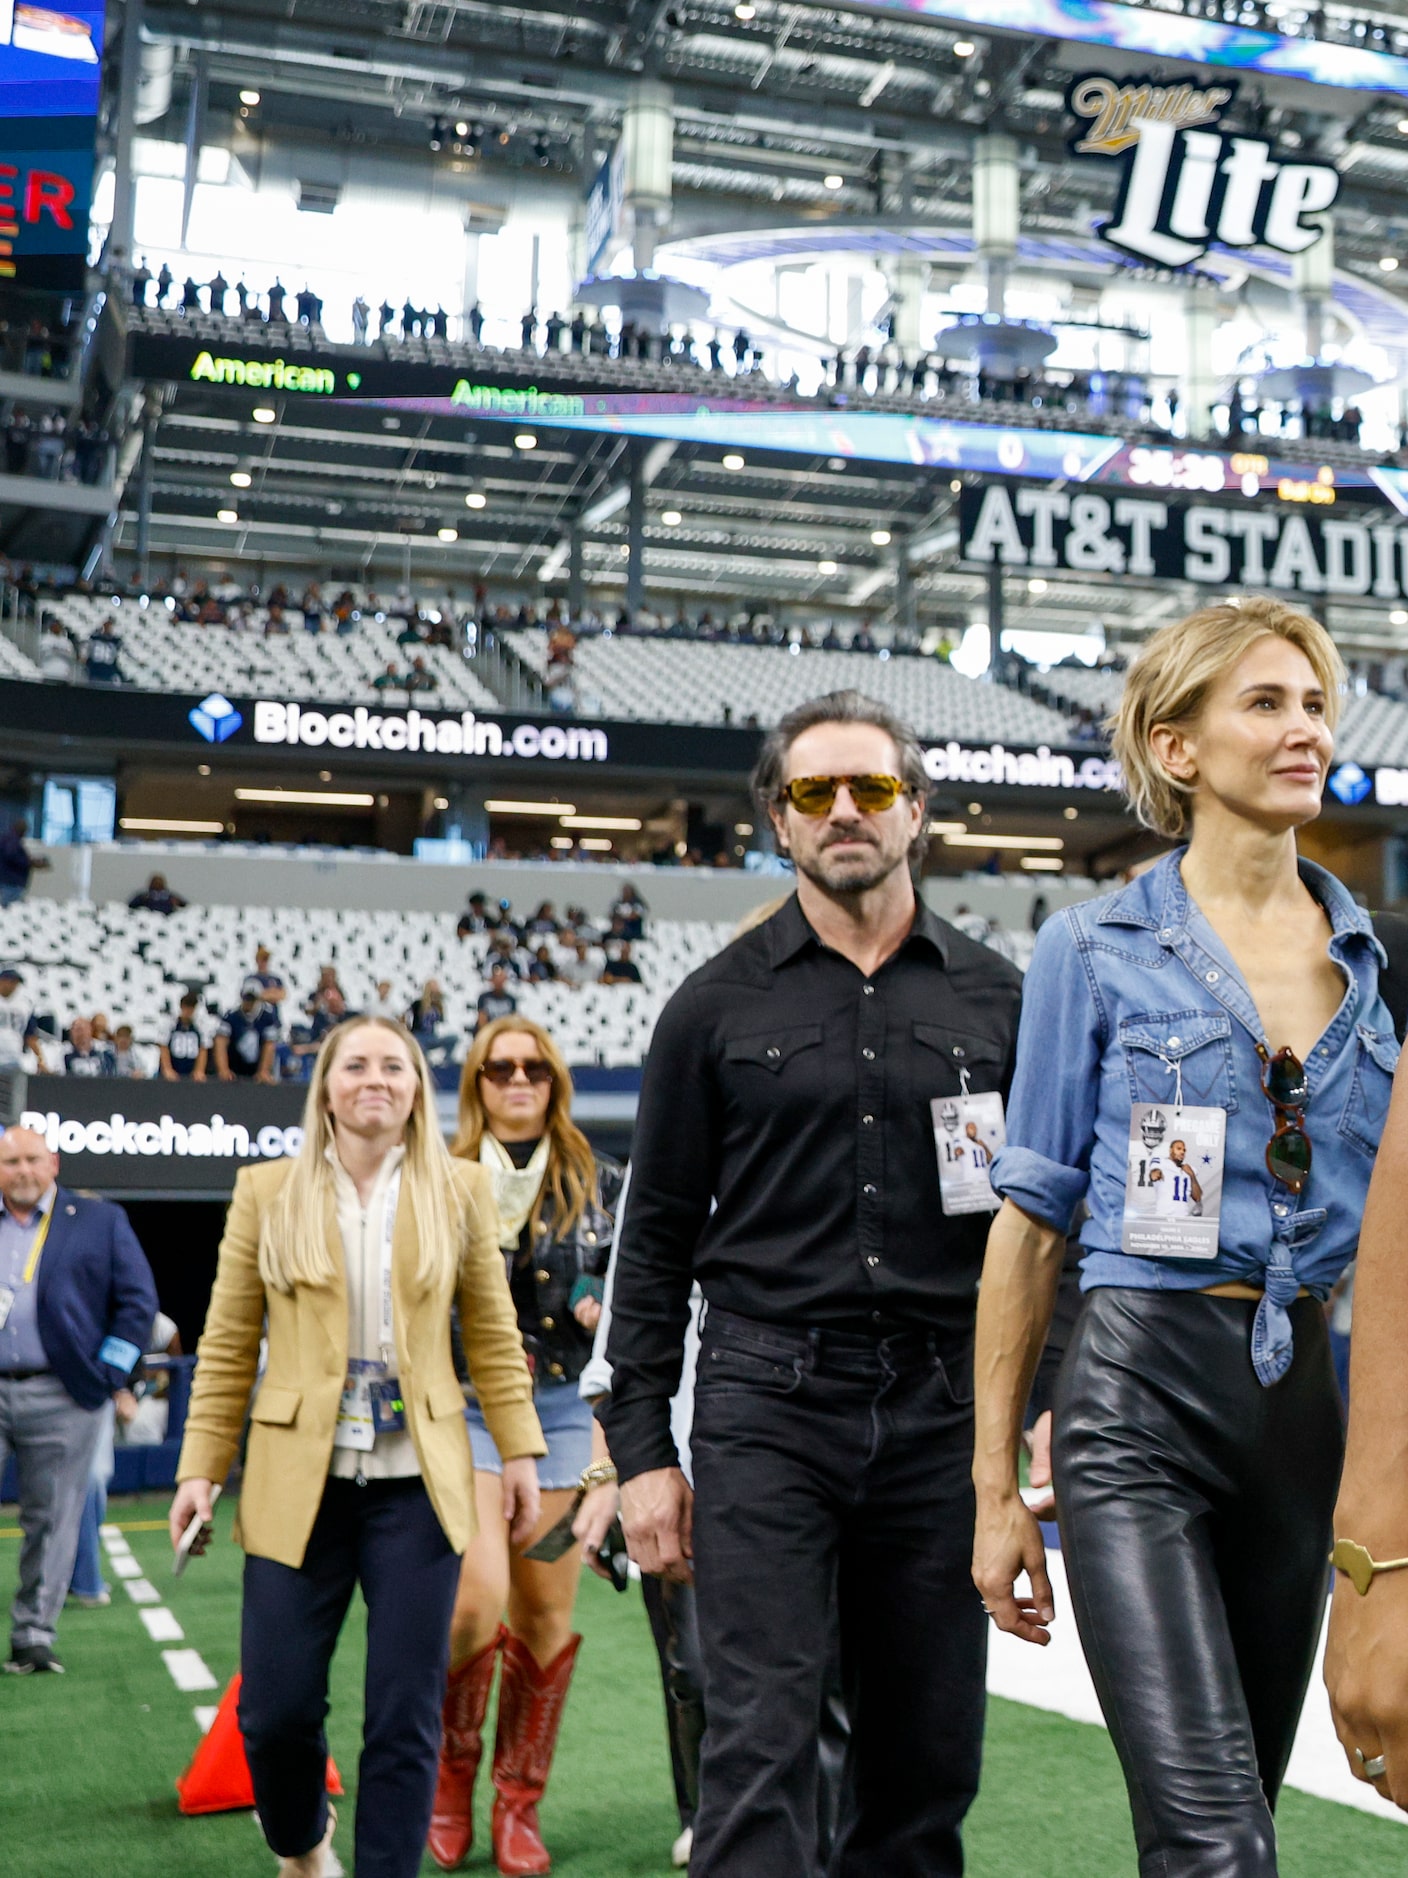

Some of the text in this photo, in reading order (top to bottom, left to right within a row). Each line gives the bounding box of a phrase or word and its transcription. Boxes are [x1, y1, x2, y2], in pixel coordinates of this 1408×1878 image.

[1071, 77, 1231, 155] Miller
[1105, 116, 1339, 266] Lite
[190, 350, 336, 395] American
[967, 487, 1168, 575] AT&T
[254, 700, 608, 762] Blockchain.com
[1173, 1175, 1188, 1203] 11
